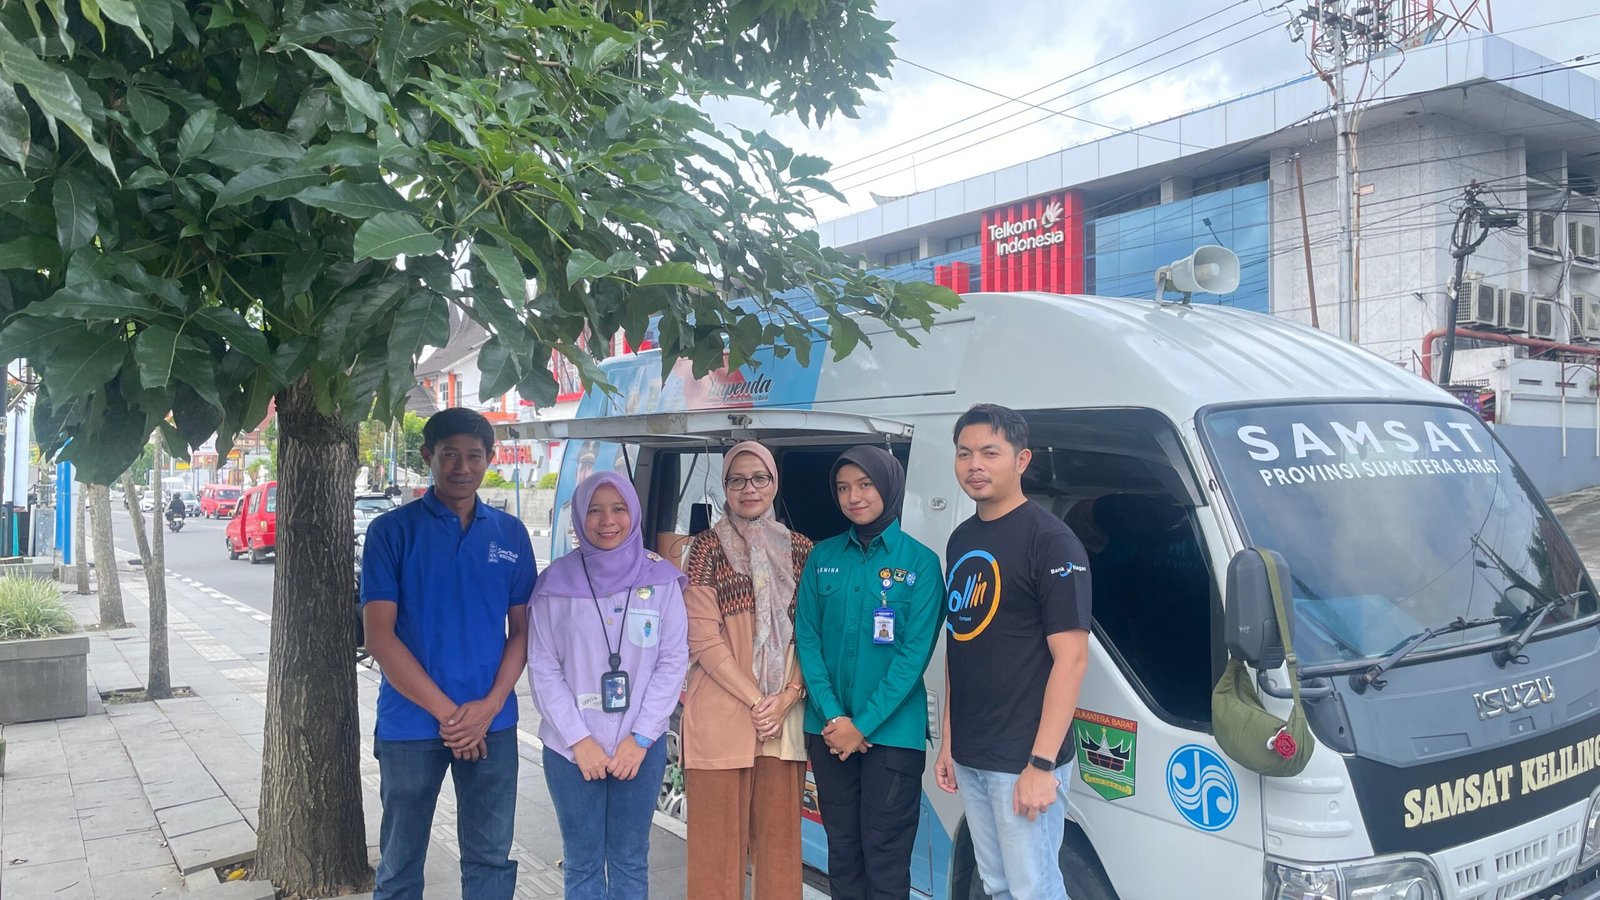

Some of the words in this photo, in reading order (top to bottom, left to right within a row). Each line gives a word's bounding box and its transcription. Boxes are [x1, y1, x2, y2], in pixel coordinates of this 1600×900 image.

[988, 218, 1036, 240] Telkom
[997, 231, 1064, 256] Indonesia
[1237, 420, 1482, 461] SAMSAT
[1259, 462, 1362, 487] PROVINSI
[1361, 458, 1456, 478] SUMATERA
[1453, 458, 1502, 474] BARAT
[1051, 567, 1065, 575] Bank
[1472, 675, 1556, 721] ISUZU
[1111, 718, 1134, 729] BARAT
[1403, 765, 1514, 828] SAMSAT
